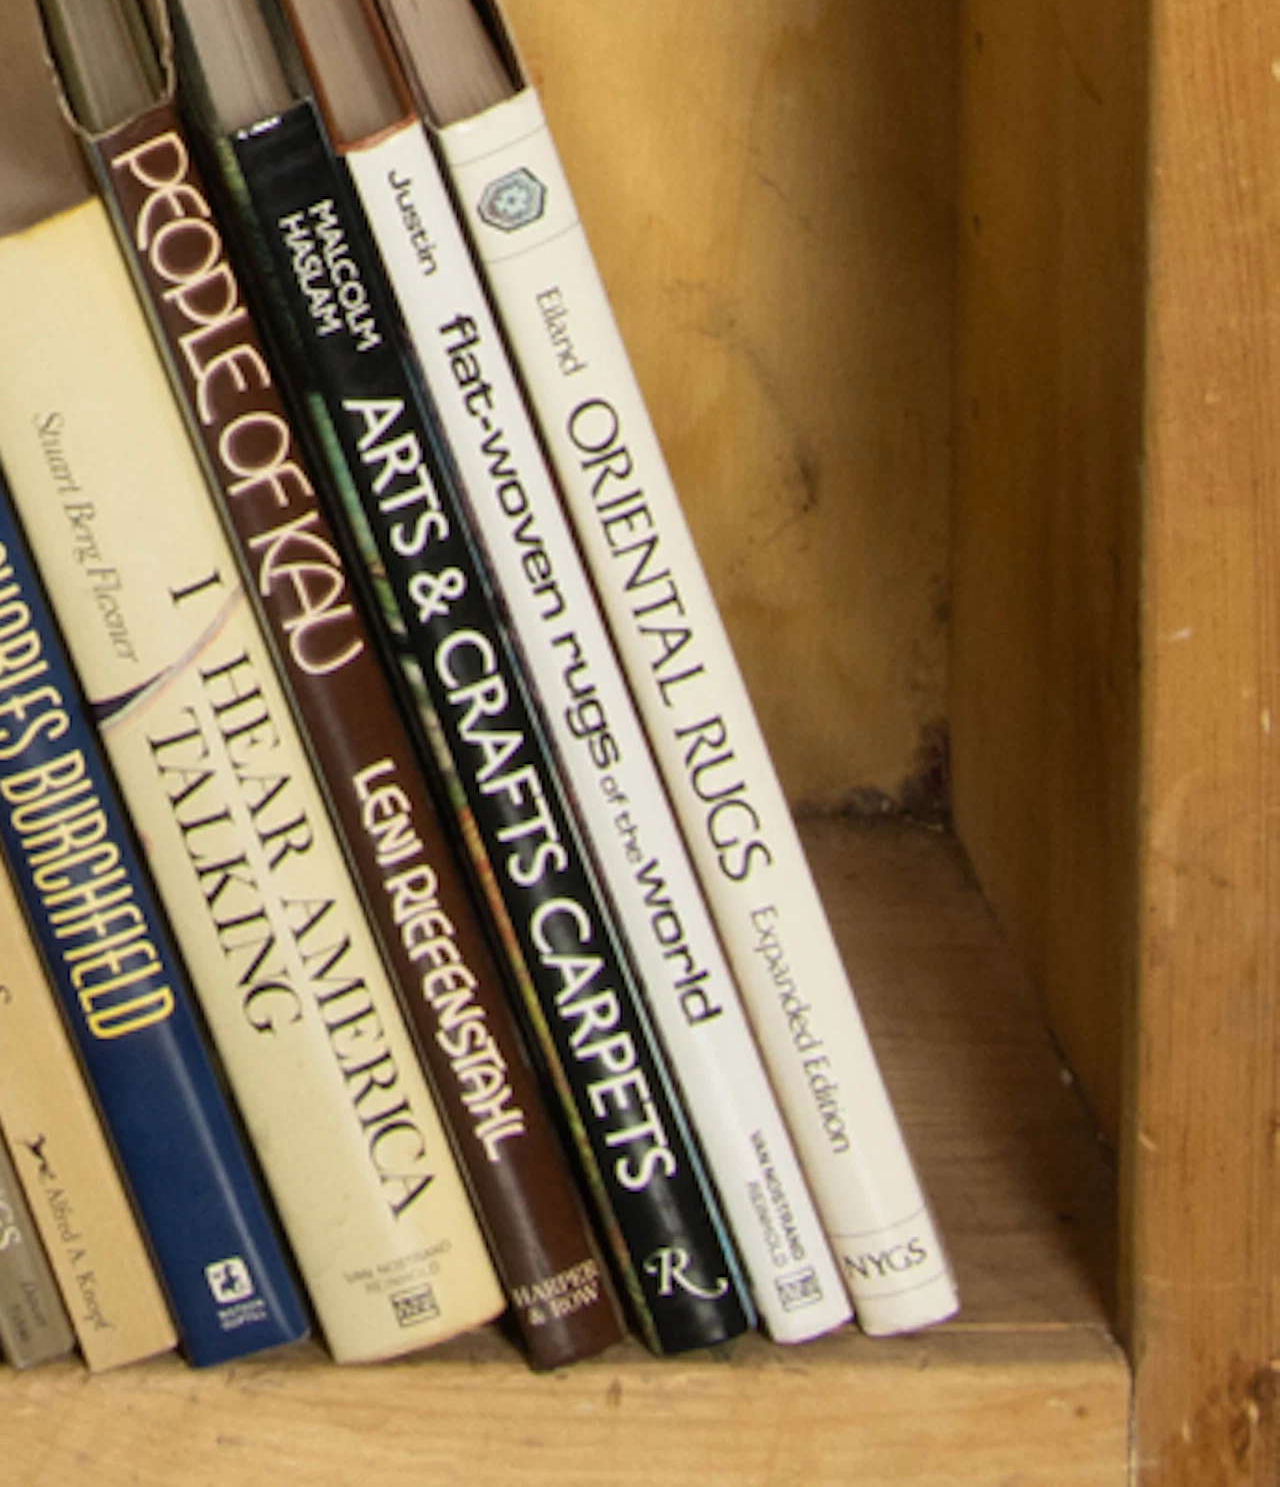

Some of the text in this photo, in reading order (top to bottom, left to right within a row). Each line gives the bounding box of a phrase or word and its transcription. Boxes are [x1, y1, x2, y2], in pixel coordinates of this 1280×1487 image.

[104, 126, 375, 684] PEOPLE OF KAU
[276, 209, 344, 338] HASLAM
[306, 196, 383, 353] MALCOLM
[165, 568, 226, 608] I
[434, 310, 724, 1025] flat-woven rugs of the world
[560, 392, 777, 885] ORIENTAL RUGS
[137, 704, 311, 1044] TALKING
[192, 648, 323, 874] HEAR
[340, 381, 682, 1192] ARTS & CRAFTS CARPETS
[344, 758, 427, 867] LENI
[276, 884, 448, 1221] AMERICA
[377, 863, 535, 1165] RIEFENSTAHL
[740, 902, 861, 1155] Expanded Edition
[842, 1236, 928, 1278] NYGS
